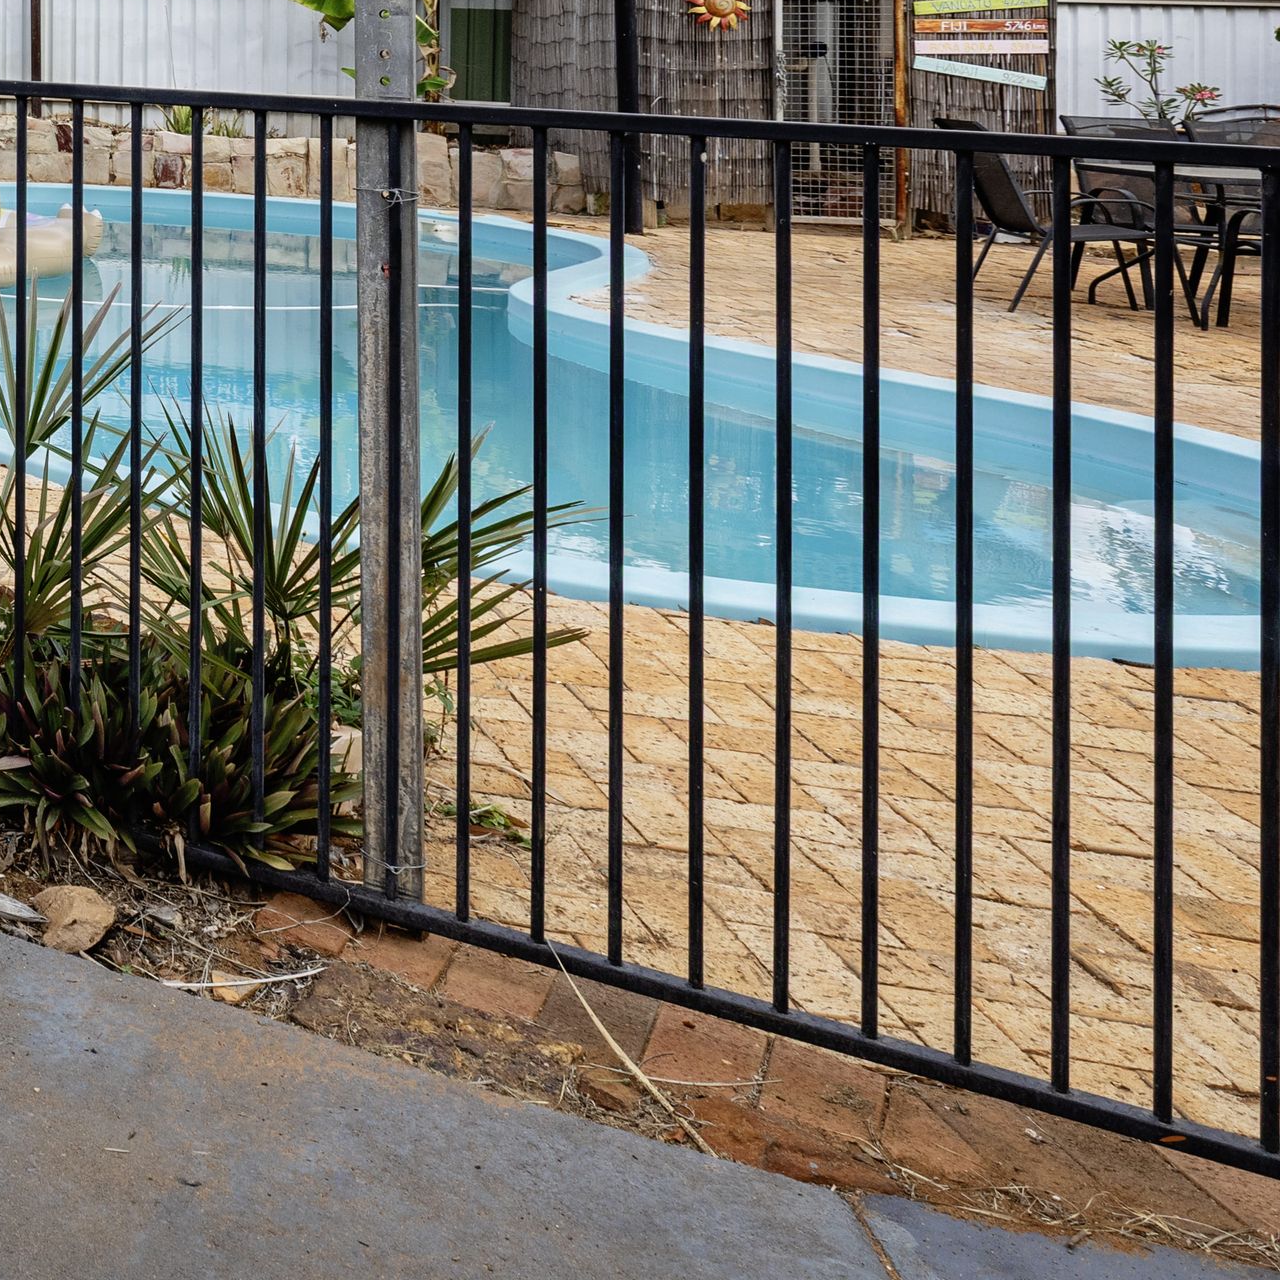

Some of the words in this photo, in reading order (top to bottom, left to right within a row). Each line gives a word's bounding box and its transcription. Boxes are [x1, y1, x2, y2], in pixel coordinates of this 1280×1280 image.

[941, 22, 968, 32] FIJI
[1004, 21, 1032, 31] 5746
[935, 61, 979, 77] HAWAII
